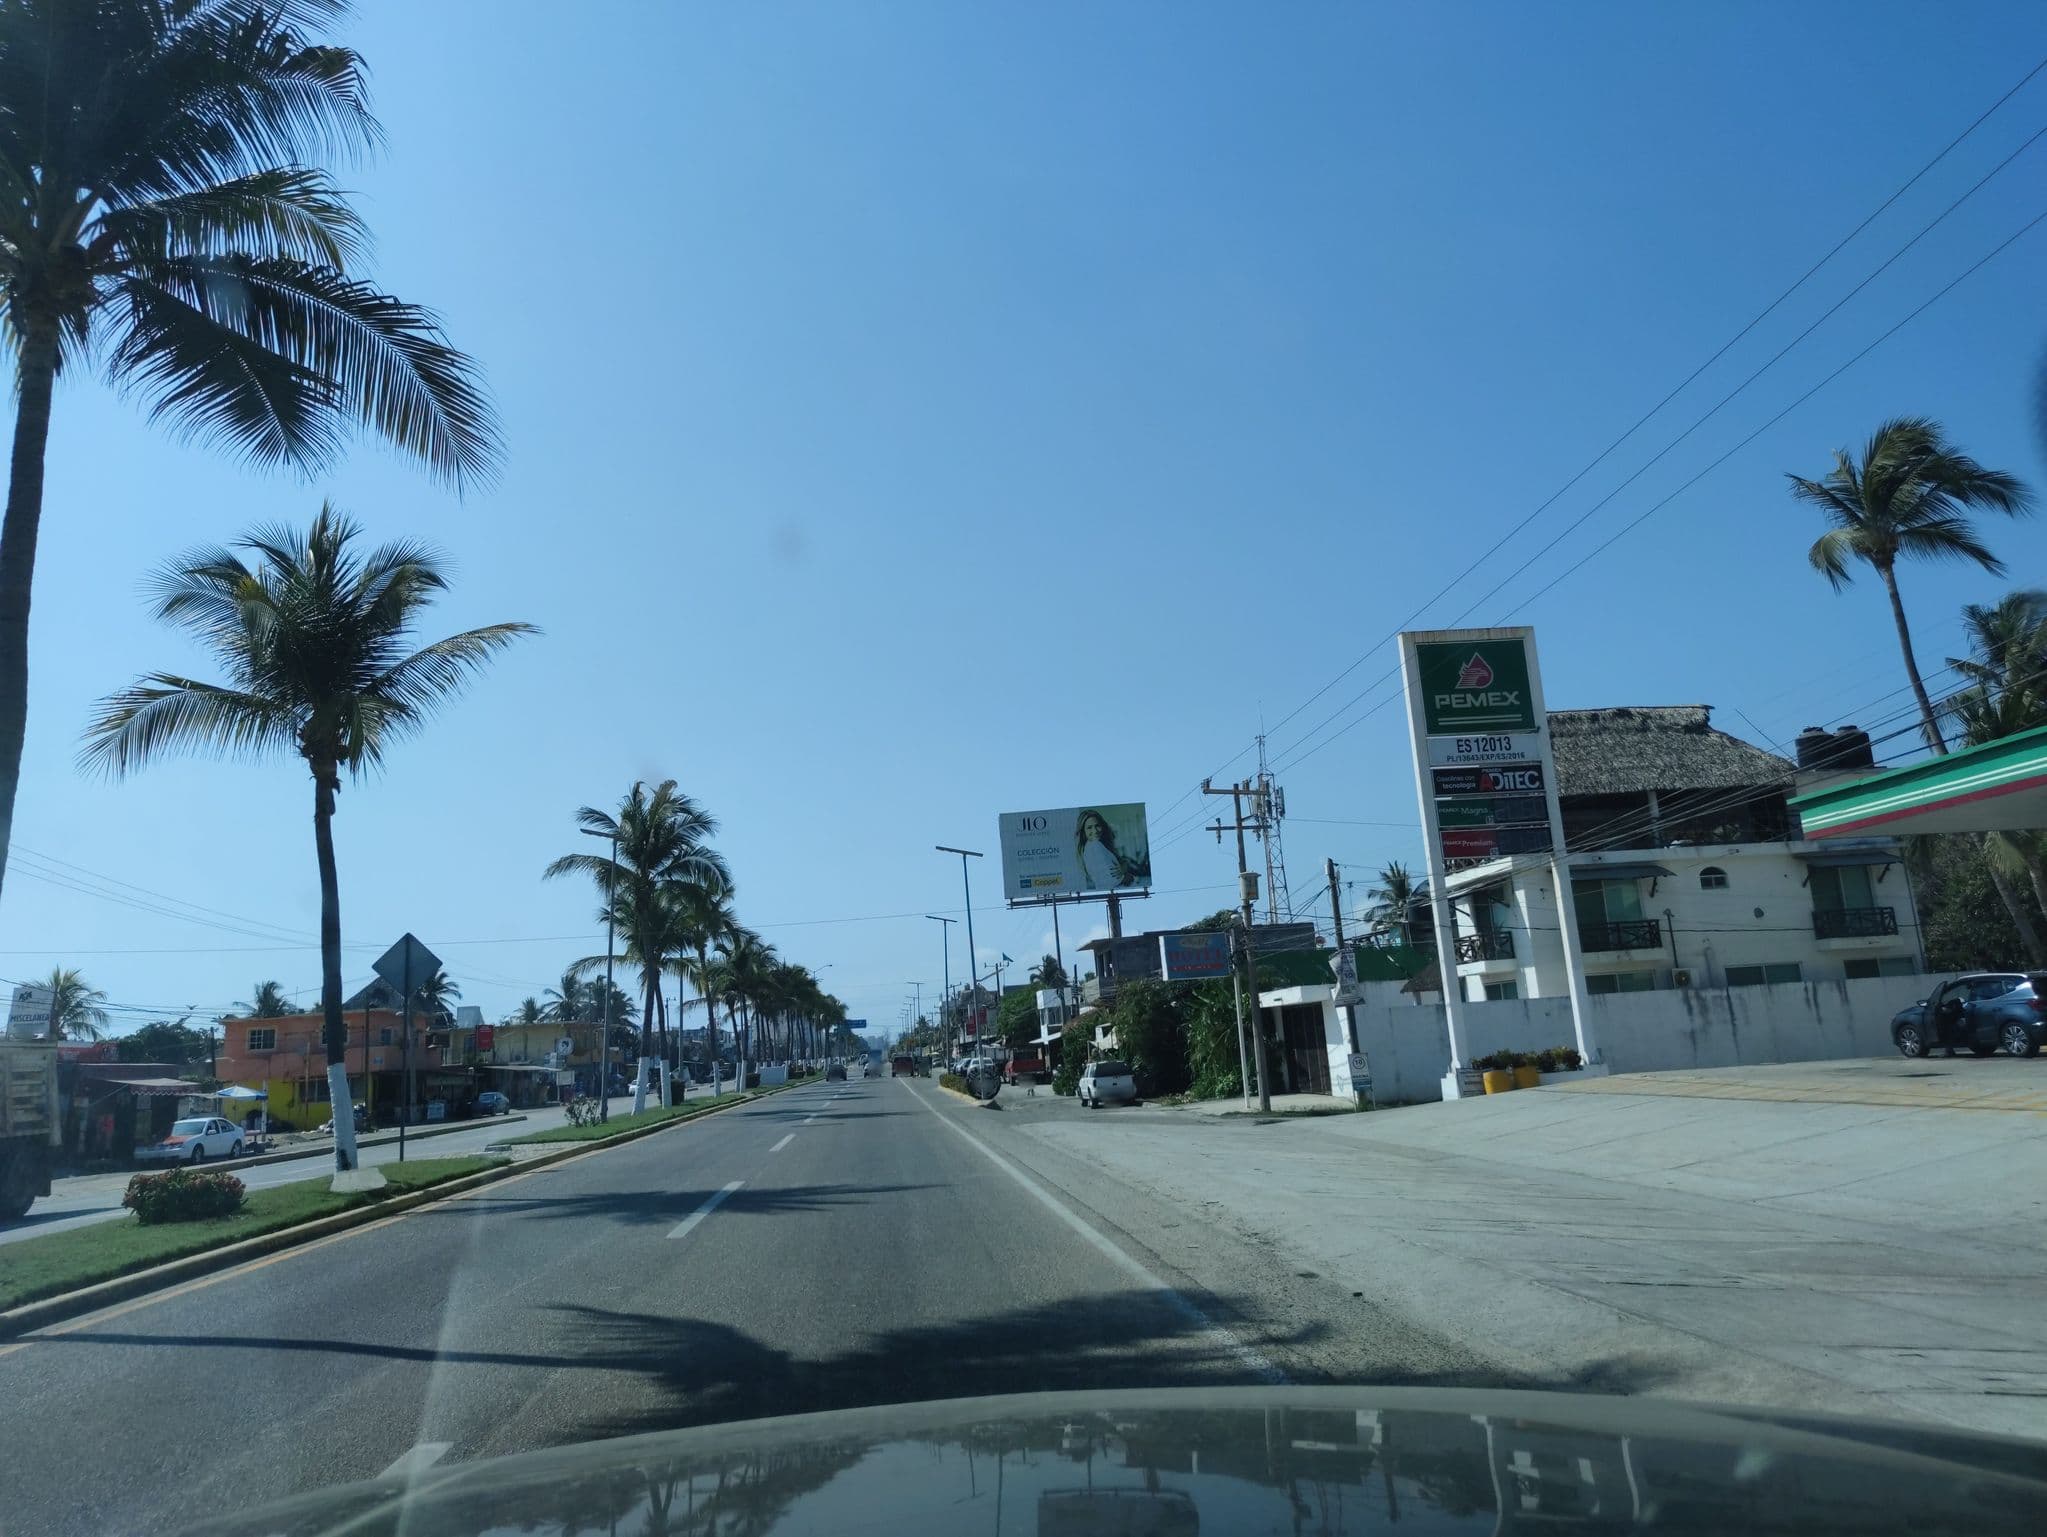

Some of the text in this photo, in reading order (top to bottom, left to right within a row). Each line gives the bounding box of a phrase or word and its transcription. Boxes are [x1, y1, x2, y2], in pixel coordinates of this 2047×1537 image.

[1434, 691, 1521, 709] PEMEX
[1456, 736, 1512, 753] ES 12013
[1461, 807, 1488, 816] Magna
